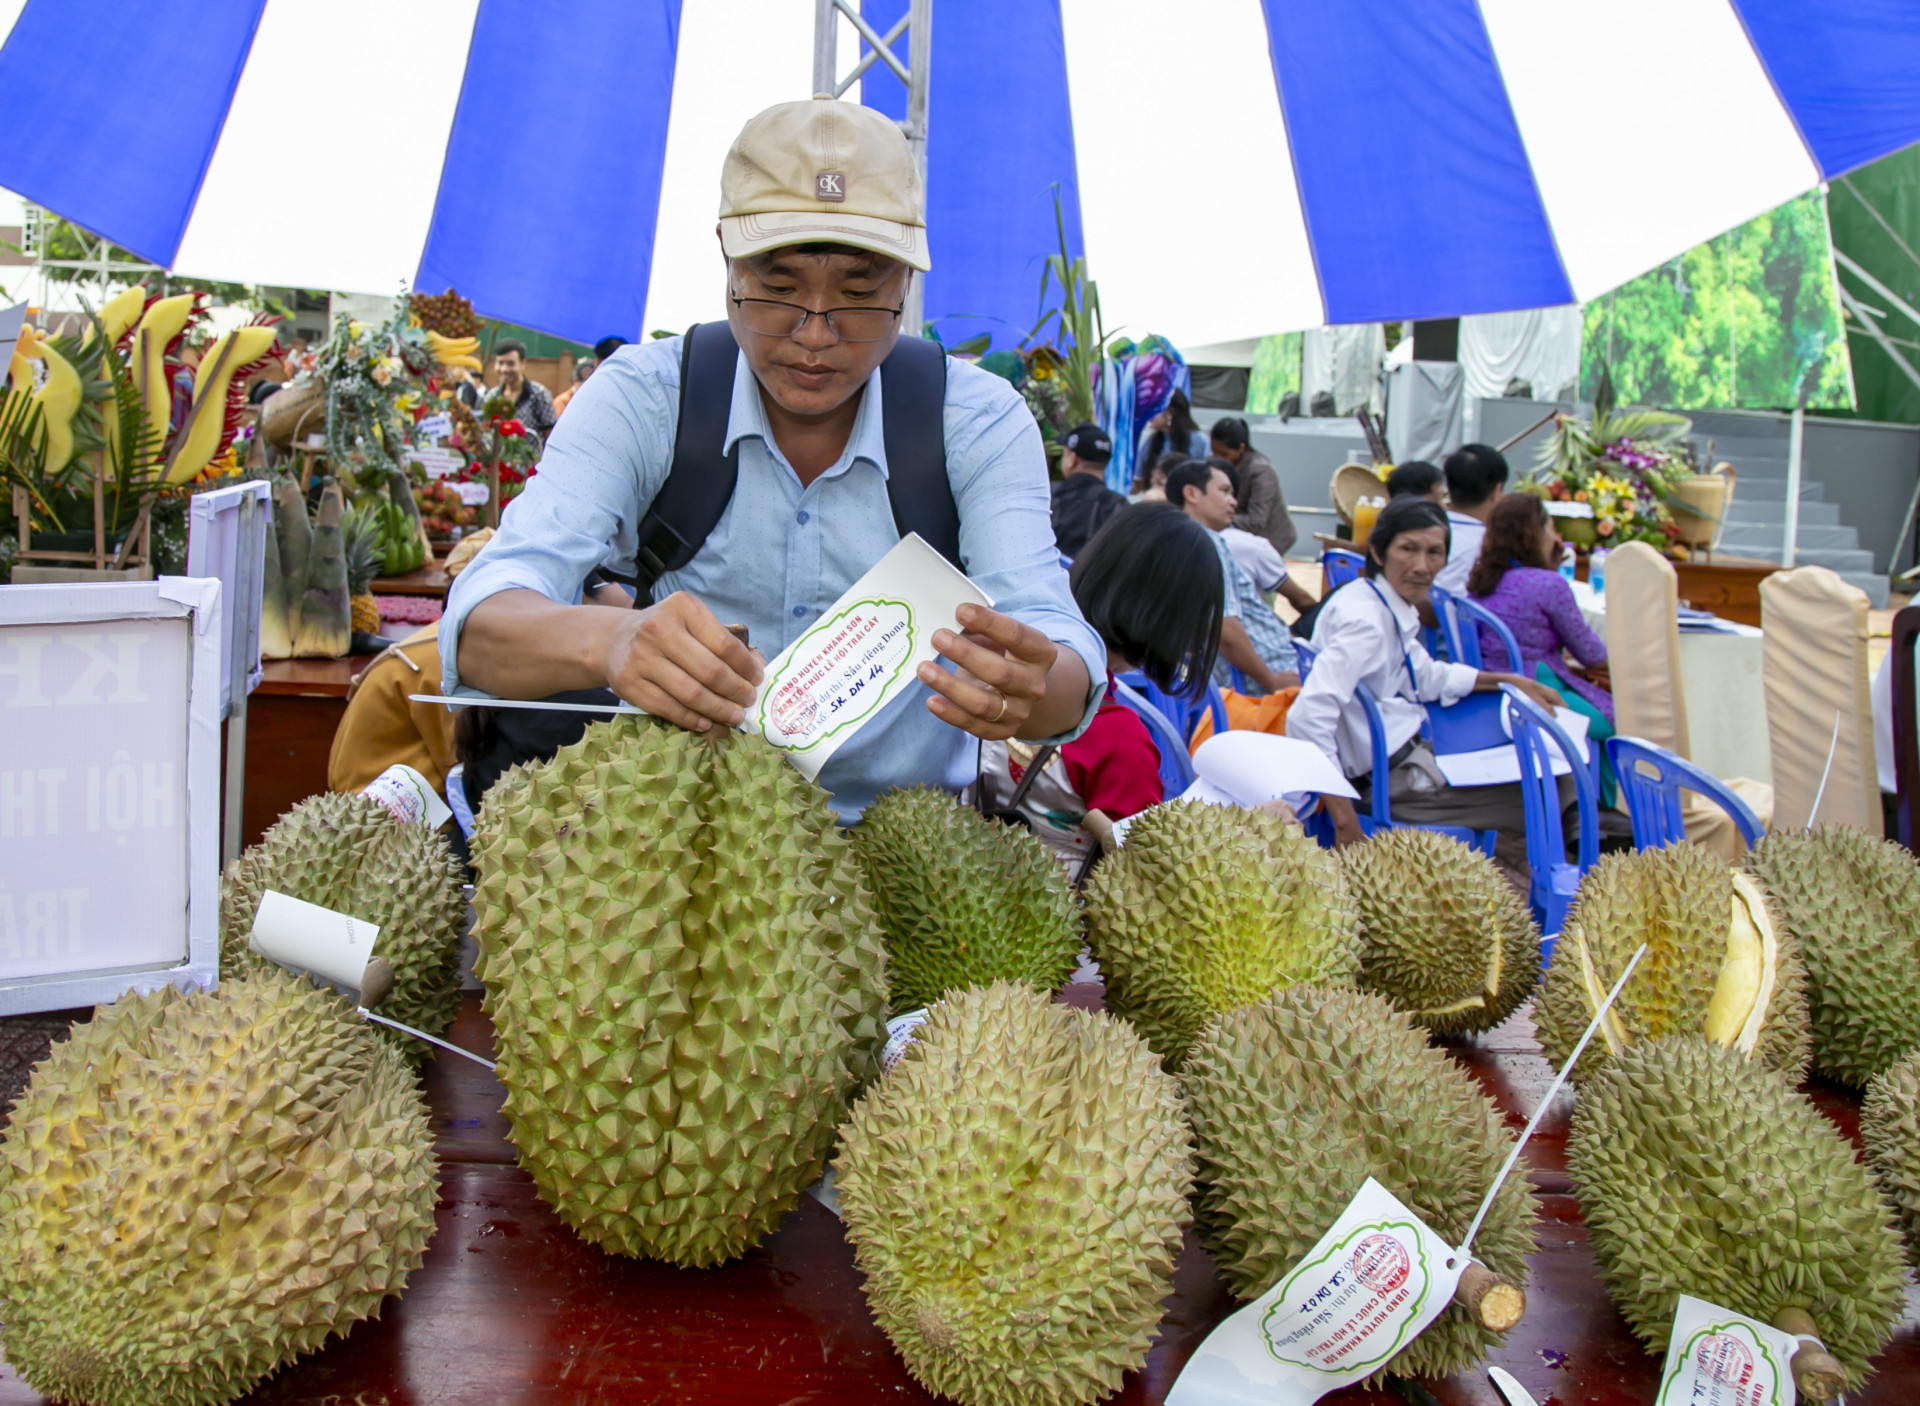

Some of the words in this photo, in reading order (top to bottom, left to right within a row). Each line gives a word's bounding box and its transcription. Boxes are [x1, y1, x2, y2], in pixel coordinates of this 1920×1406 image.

[777, 677, 799, 697] UBND
[798, 654, 824, 678] HUYỆN
[822, 630, 848, 656] KHÁNH
[846, 616, 863, 632] SƠN
[820, 691, 831, 704] dự
[844, 665, 862, 681] Sầu
[861, 642, 886, 665] riêng
[882, 621, 906, 644] Dona
[777, 698, 793, 717] BAN
[794, 686, 804, 700] TỔ
[803, 669, 825, 691] CHỨC
[834, 647, 849, 662] HỘI
[847, 631, 866, 649] TRÁI
[1354, 1240, 1372, 1259] Mã
[1378, 1239, 1397, 1258] Sản
[1356, 1256, 1380, 1285] phẩm
[1388, 1267, 1407, 1288] BAN
[1344, 1284, 1358, 1298] dự
[1377, 1286, 1390, 1302] TỔ
[1386, 1288, 1410, 1313] UBND
[1313, 1308, 1333, 1325] Sầu
[1356, 1298, 1379, 1321] CHỨC
[1295, 1322, 1315, 1340] riêng
[1345, 1319, 1358, 1332] LỄ
[1360, 1312, 1388, 1337] HUYỆN
[1332, 1328, 1348, 1342] HỘI
[1316, 1339, 1334, 1353] TRÁI
[1336, 1335, 1363, 1358] KHÁNH
[1739, 1364, 1753, 1386] BAN
[1736, 1386, 1748, 1400] TỔ
